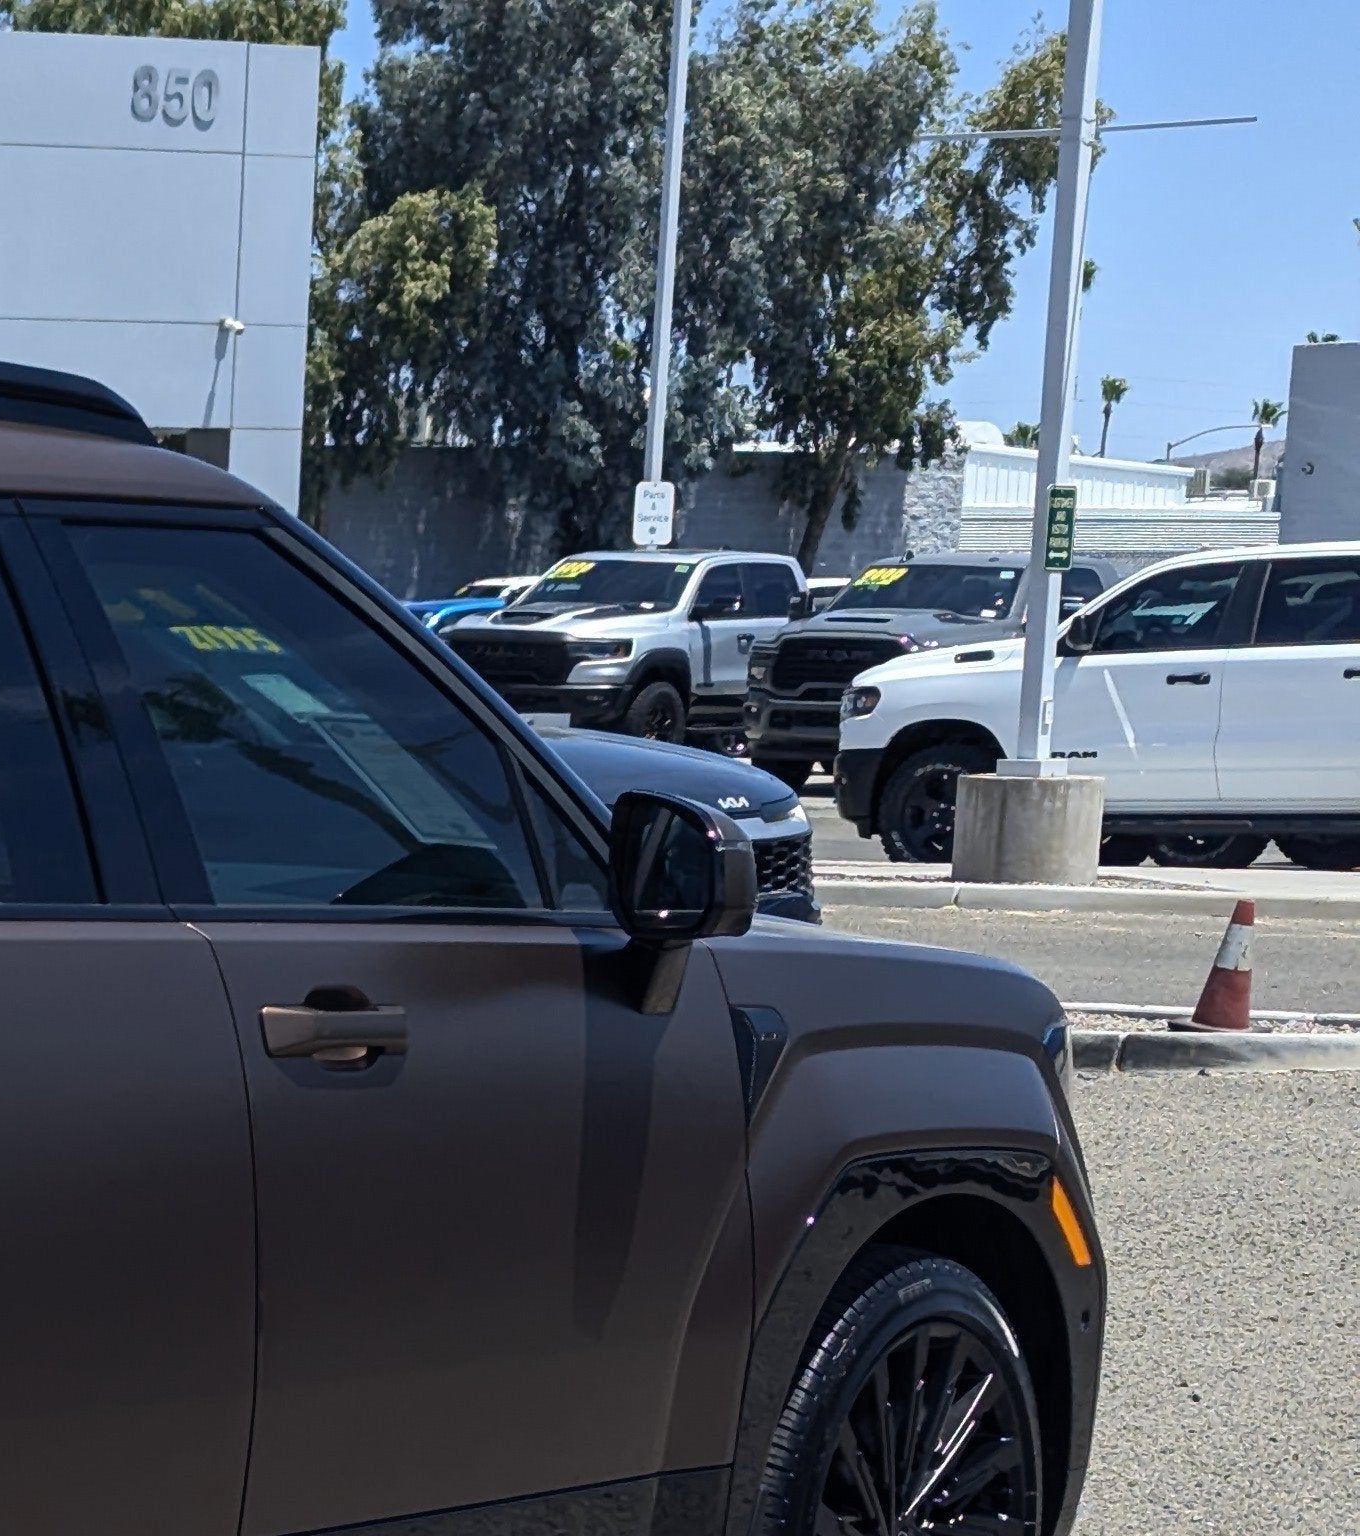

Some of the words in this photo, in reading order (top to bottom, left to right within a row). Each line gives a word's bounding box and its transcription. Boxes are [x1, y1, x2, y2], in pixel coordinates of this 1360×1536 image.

[131, 65, 219, 132] 850
[643, 490, 666, 499] Parts
[637, 513, 669, 522] Service
[1051, 751, 1098, 759] RAM
